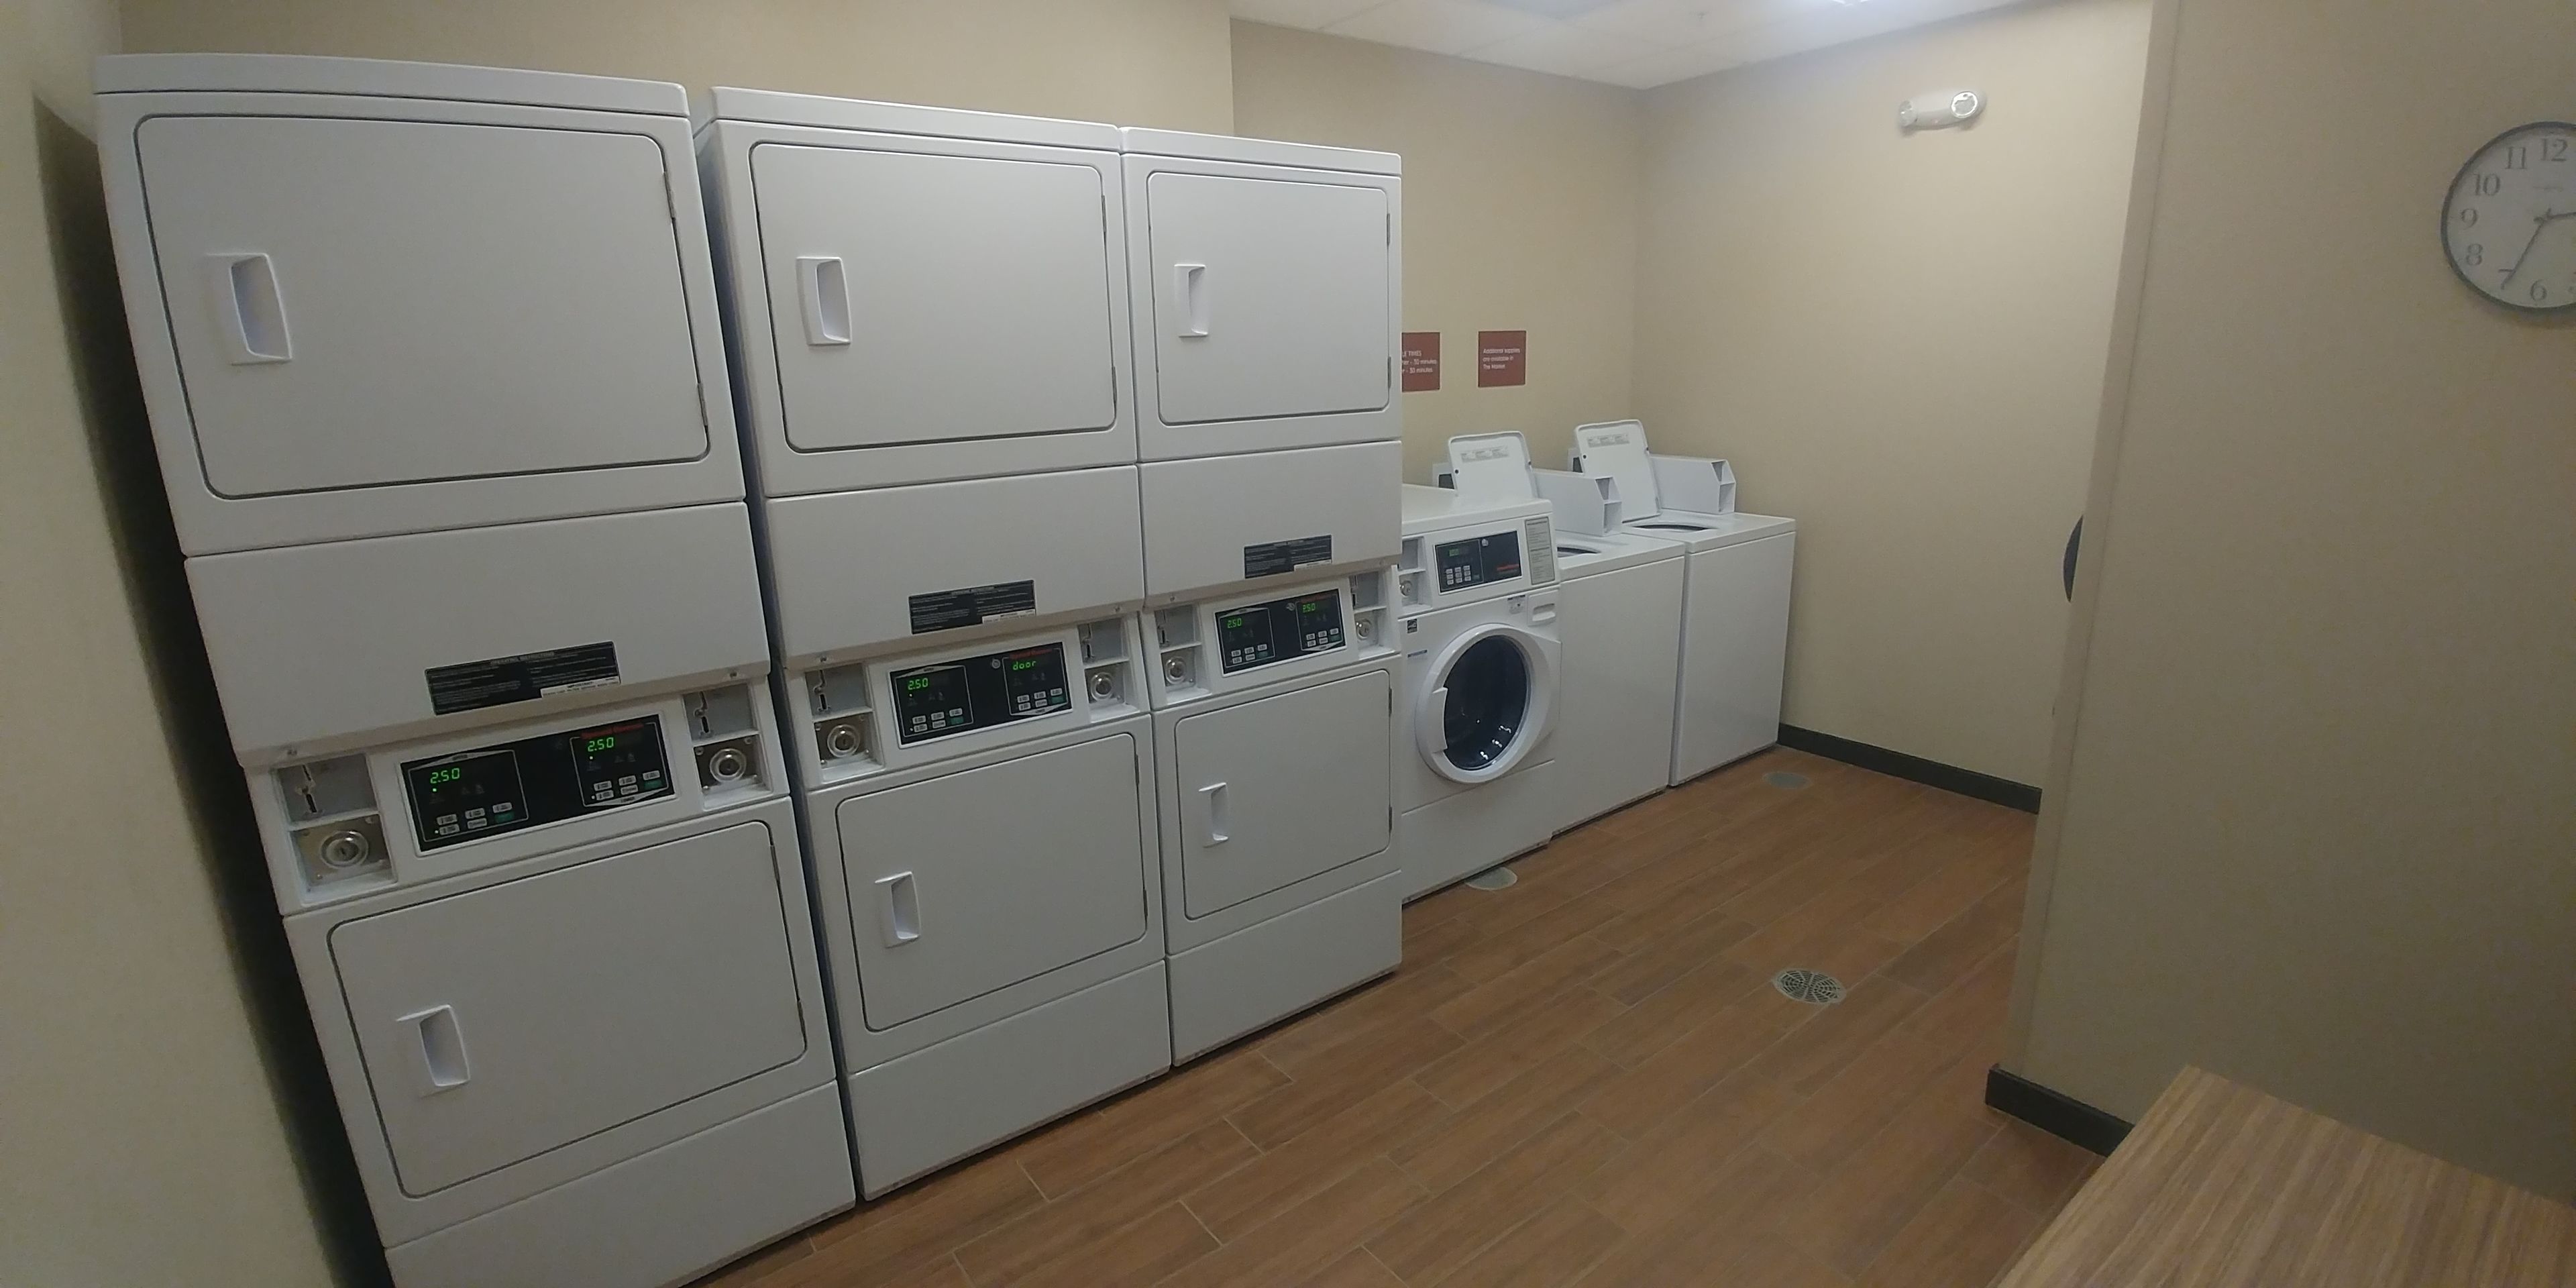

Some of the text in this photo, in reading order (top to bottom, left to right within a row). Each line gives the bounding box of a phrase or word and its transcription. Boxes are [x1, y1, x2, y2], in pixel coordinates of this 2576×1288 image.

[2504, 146, 2527, 170] 11
[2540, 138, 2568, 162] 12
[2473, 172, 2501, 197] 10
[2461, 207, 2479, 230] 9
[2466, 243, 2483, 266] 8
[2498, 268, 2516, 290] 7
[2530, 279, 2548, 302] 6
[1227, 618, 1242, 629] 2.50
[1012, 660, 1036, 670] door
[908, 678, 928, 690] 2.50
[588, 737, 614, 753] 2.50
[429, 767, 461, 785] 2.50
